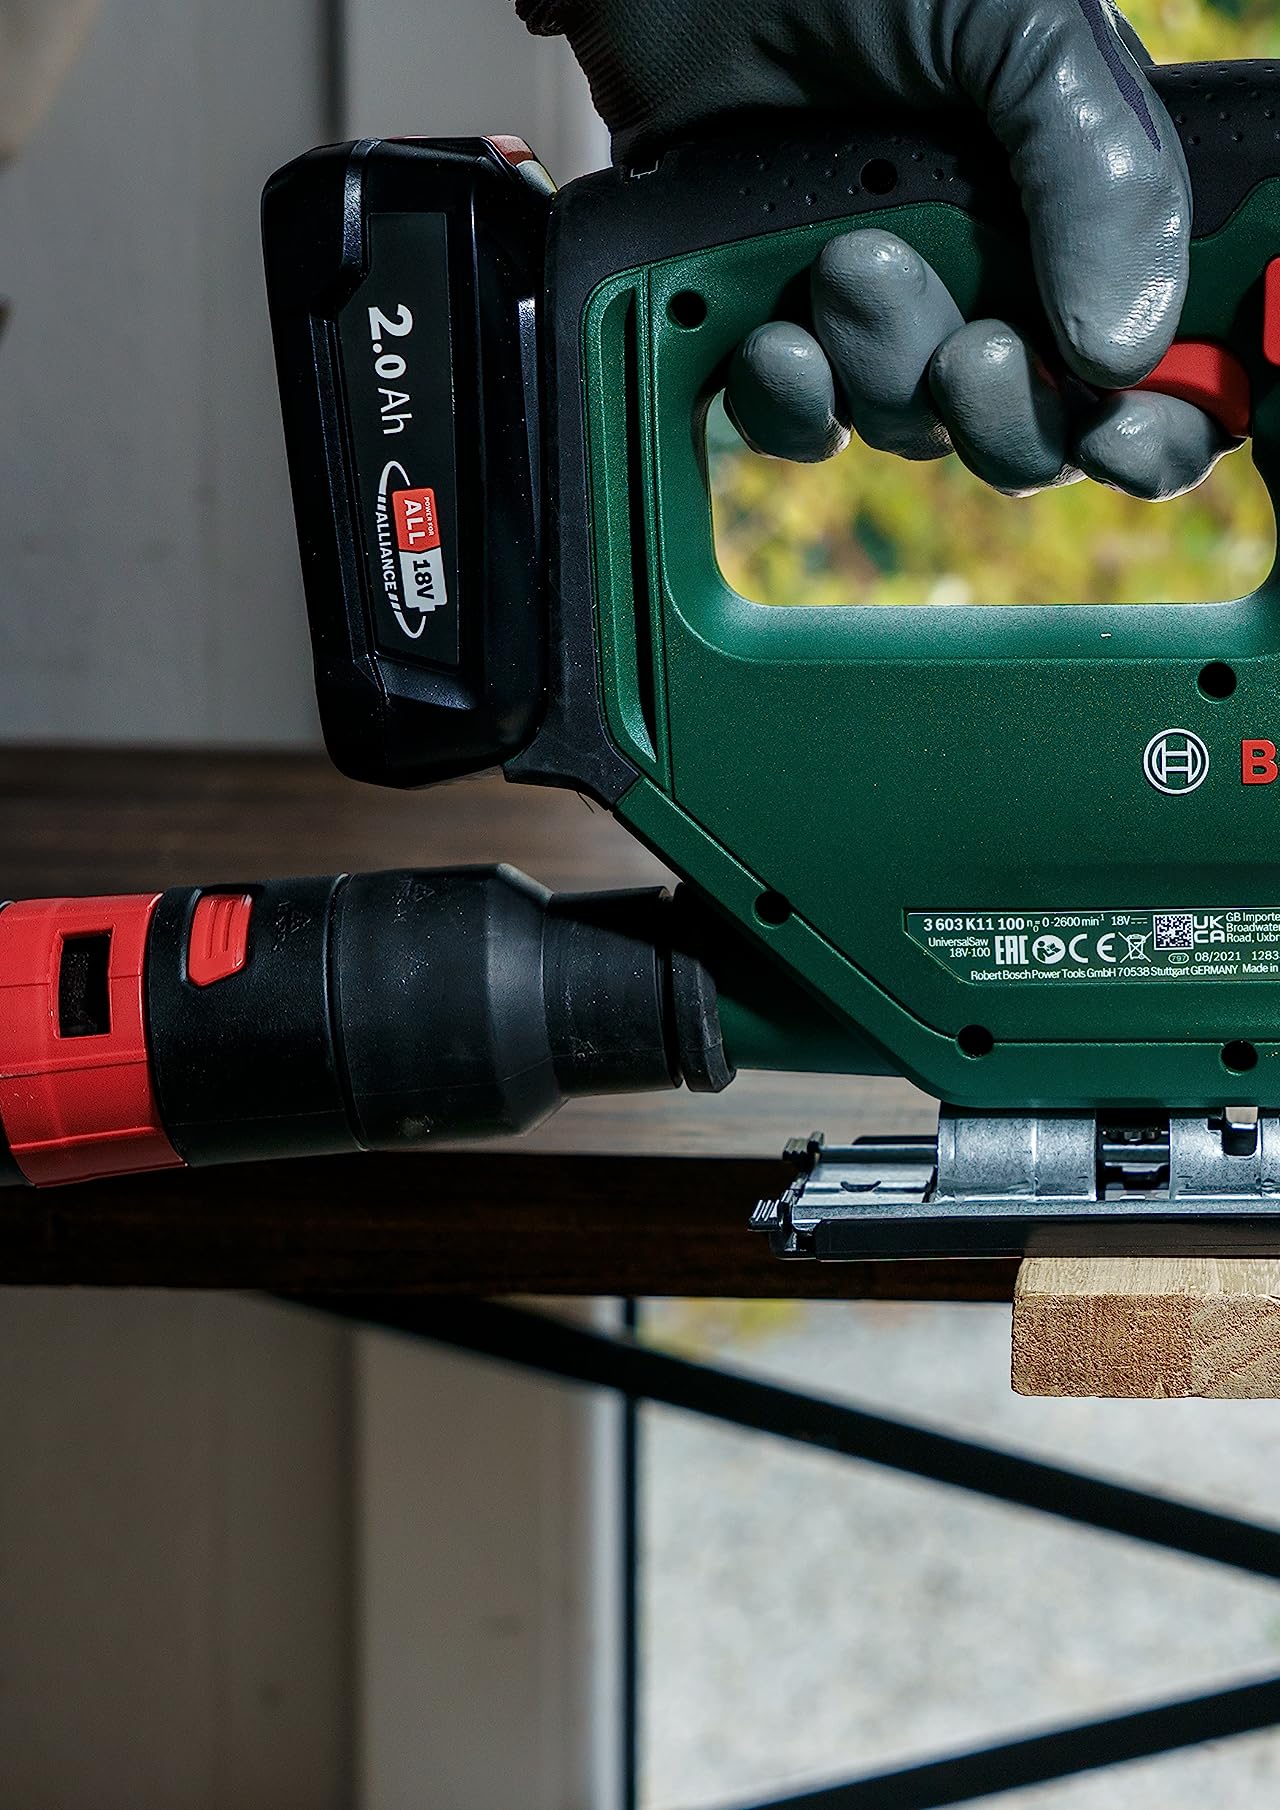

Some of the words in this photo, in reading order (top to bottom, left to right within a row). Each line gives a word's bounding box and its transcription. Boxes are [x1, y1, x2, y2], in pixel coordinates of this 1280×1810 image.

[368, 304, 413, 379] 2.0
[378, 387, 412, 434] Ah
[424, 496, 433, 521] POWER
[403, 499, 426, 545] ALL
[427, 522, 435, 536] FOR
[375, 511, 398, 591] ALLIANCE
[412, 559, 435, 599] 18V
[923, 918, 933, 931] 3
[935, 918, 963, 931] 603
[965, 917, 994, 931] K11
[997, 917, 1025, 930] 100
[1111, 915, 1130, 926] 18V
[1193, 915, 1225, 929] UK
[1225, 912, 1241, 922] GB
[928, 936, 989, 947] UniversalSaw
[1193, 930, 1226, 943] CA
[949, 947, 991, 958] 18V-100
[1194, 951, 1242, 963] 08/2021
[970, 970, 1002, 981] Robert
[1002, 969, 1032, 980] Bosch
[1031, 968, 1061, 980] Power
[1061, 967, 1086, 979] Tools
[1086, 966, 1117, 978] GmbH
[1117, 966, 1150, 978] 70538
[1150, 966, 1190, 978] Stuttgart
[1190, 964, 1239, 976] GERMANY
[1242, 963, 1269, 974] Made
[1269, 962, 1279, 973] in
